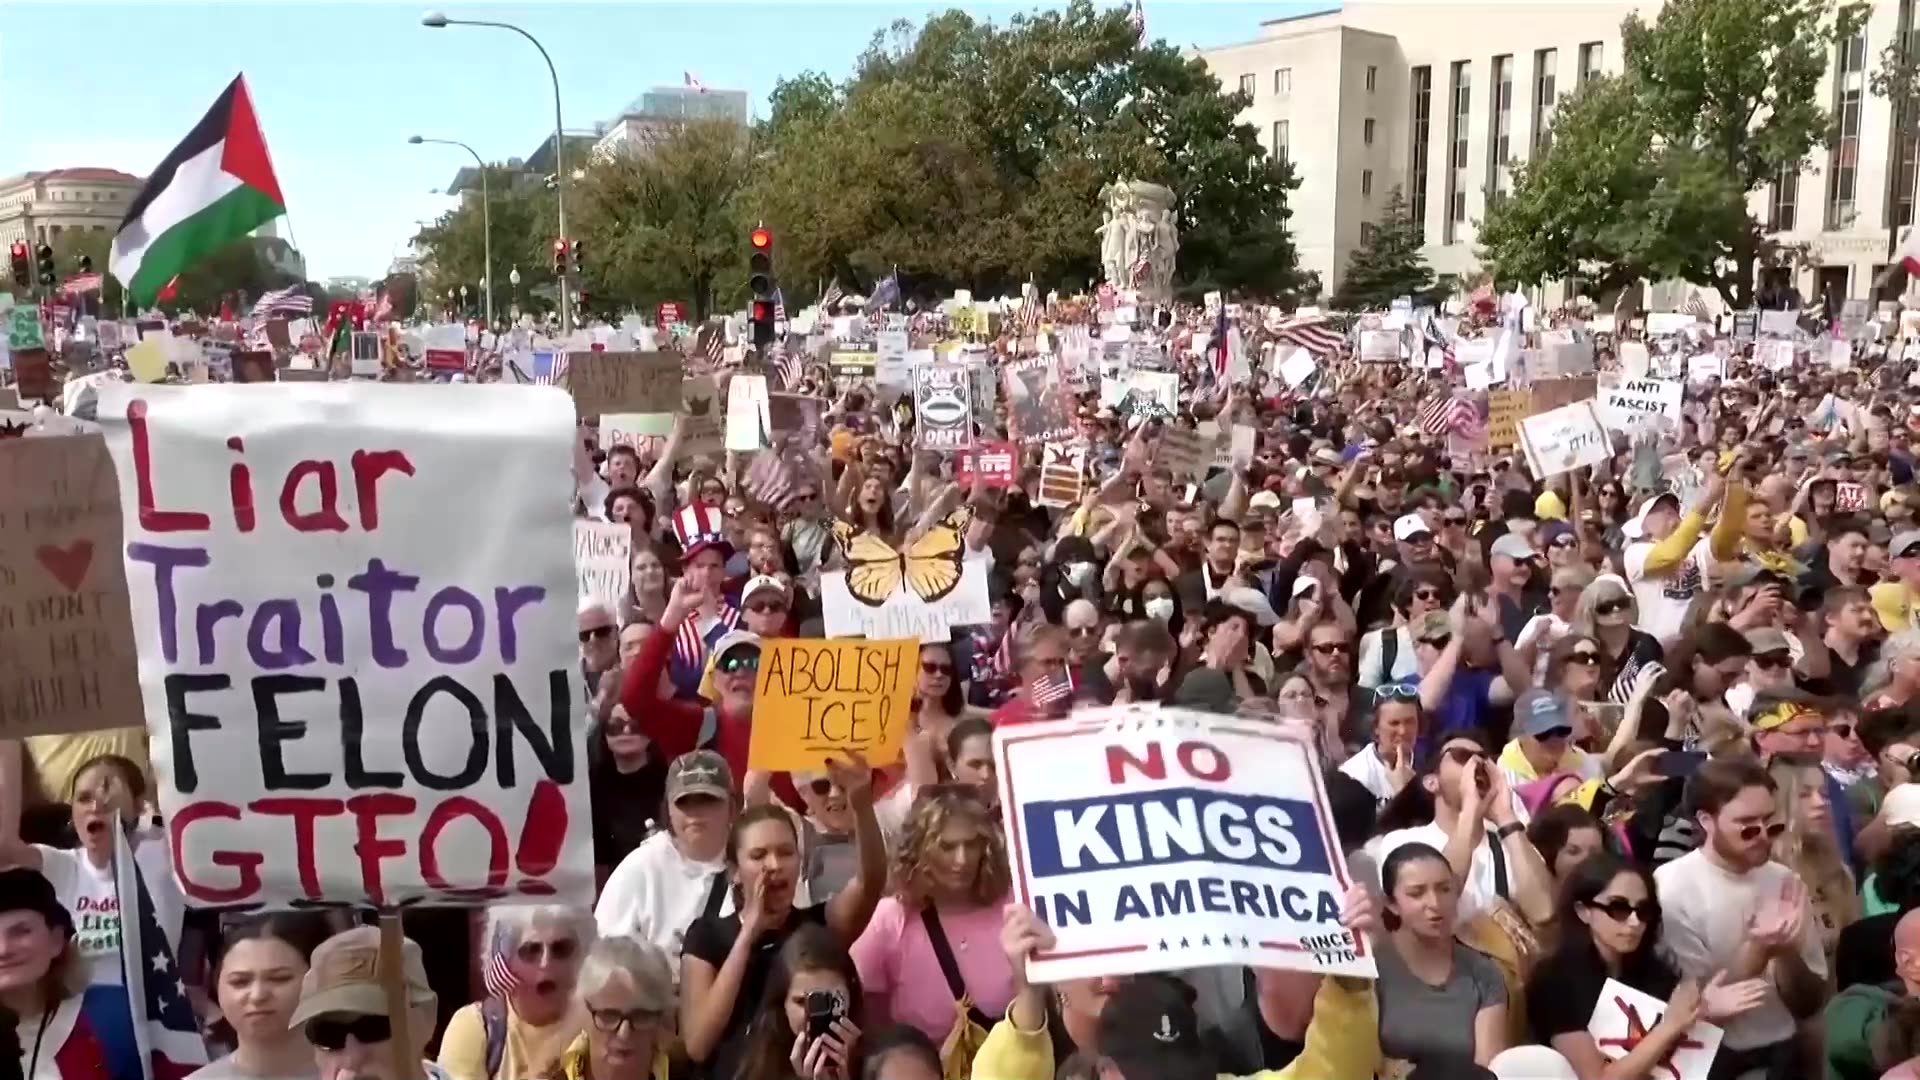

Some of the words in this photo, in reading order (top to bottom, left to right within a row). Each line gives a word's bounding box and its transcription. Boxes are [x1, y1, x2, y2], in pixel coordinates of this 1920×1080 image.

[1609, 395, 1668, 414] FASCIST
[1626, 380, 1660, 394] ANTI
[127, 399, 416, 532] Liar
[127, 541, 546, 669] Traitor
[763, 645, 902, 697] ABOLISH
[164, 669, 574, 793] FELON
[800, 695, 891, 744] ICE!
[1106, 741, 1232, 784] NO
[168, 779, 569, 902] GTFO!
[1054, 798, 1301, 868] KINGS
[1034, 889, 1092, 927] IN
[1114, 877, 1341, 925] AMERICA
[1300, 932, 1354, 952] SINCE
[1313, 950, 1355, 965] 1776
